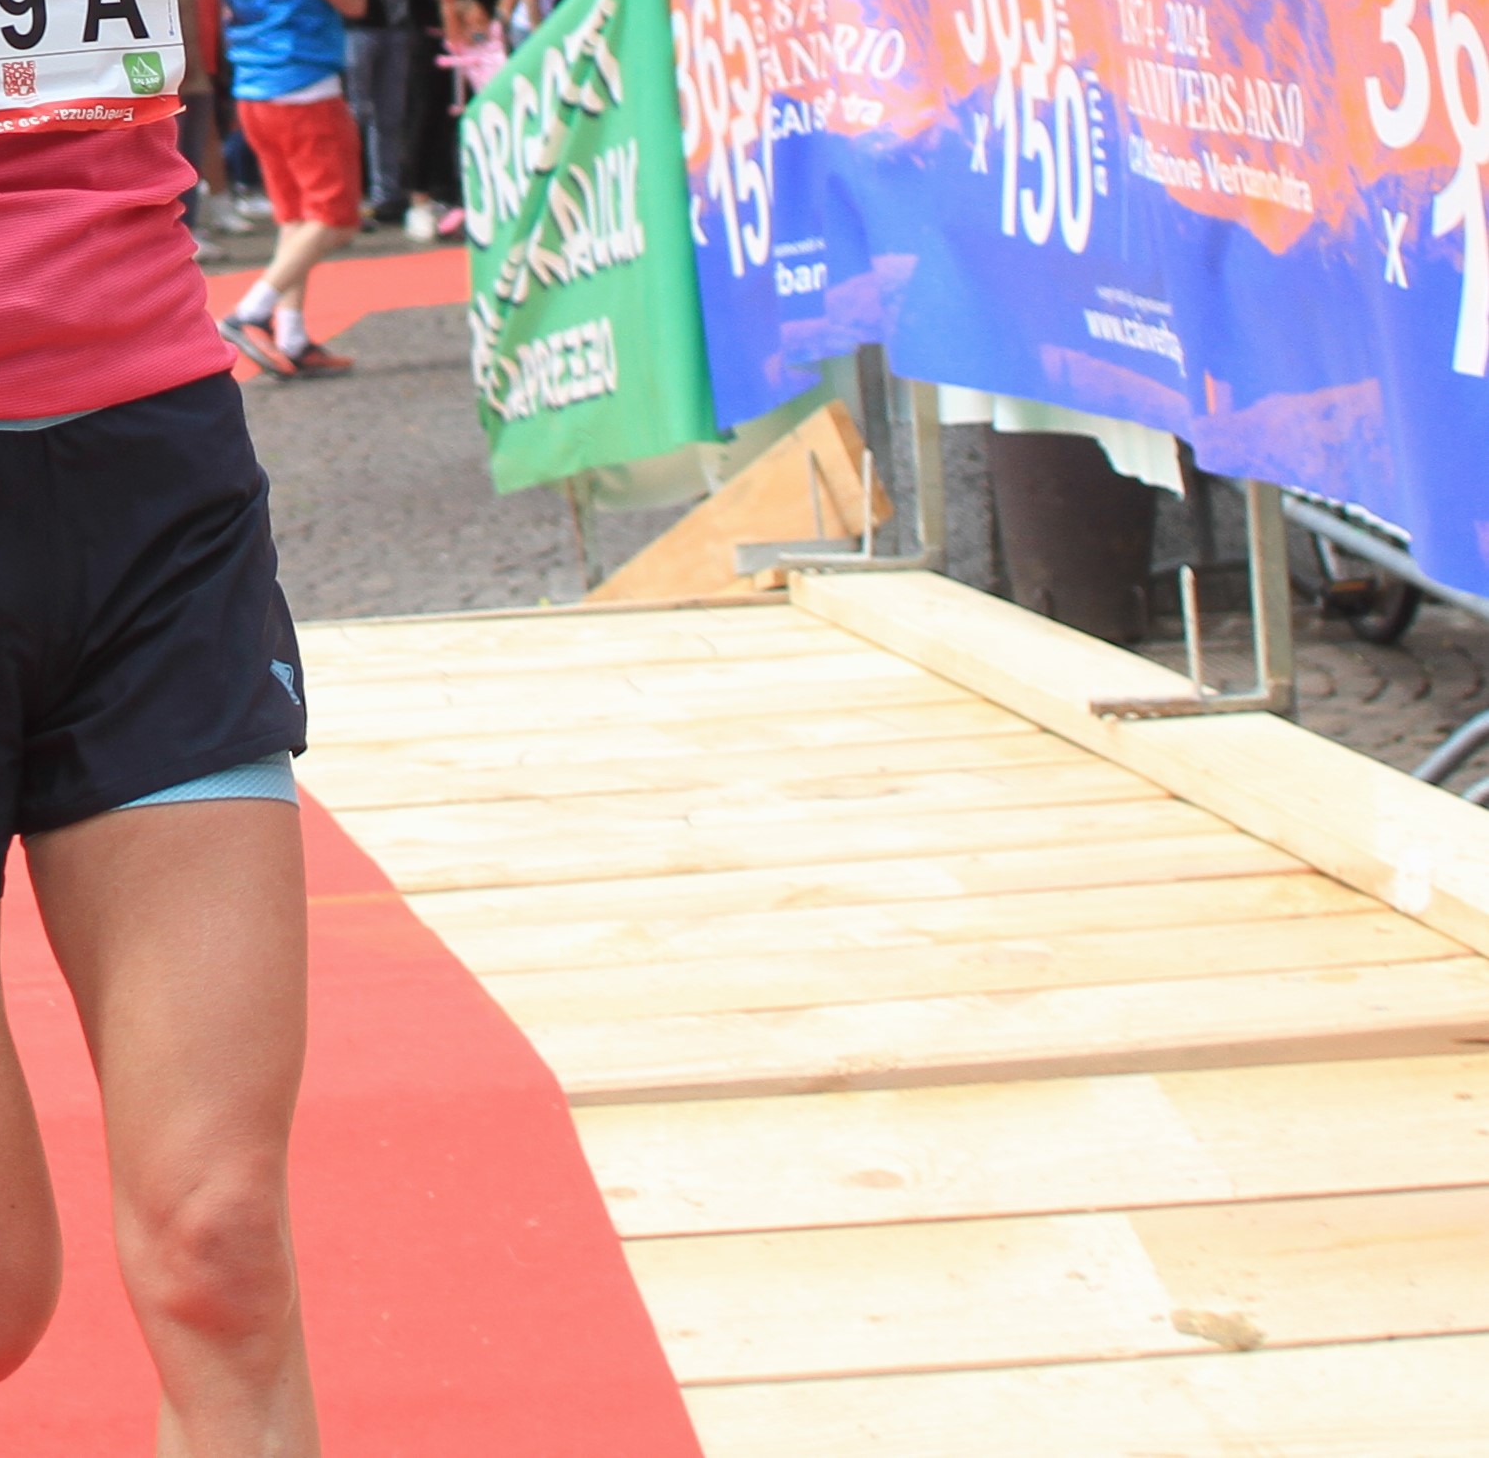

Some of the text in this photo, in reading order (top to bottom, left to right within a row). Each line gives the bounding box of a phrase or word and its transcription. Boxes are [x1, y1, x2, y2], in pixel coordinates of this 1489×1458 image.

[17, 114, 51, 129] +39
[53, 104, 134, 123] Emergenza:
[994, 63, 1094, 254] 150
[708, 94, 774, 278] 15
